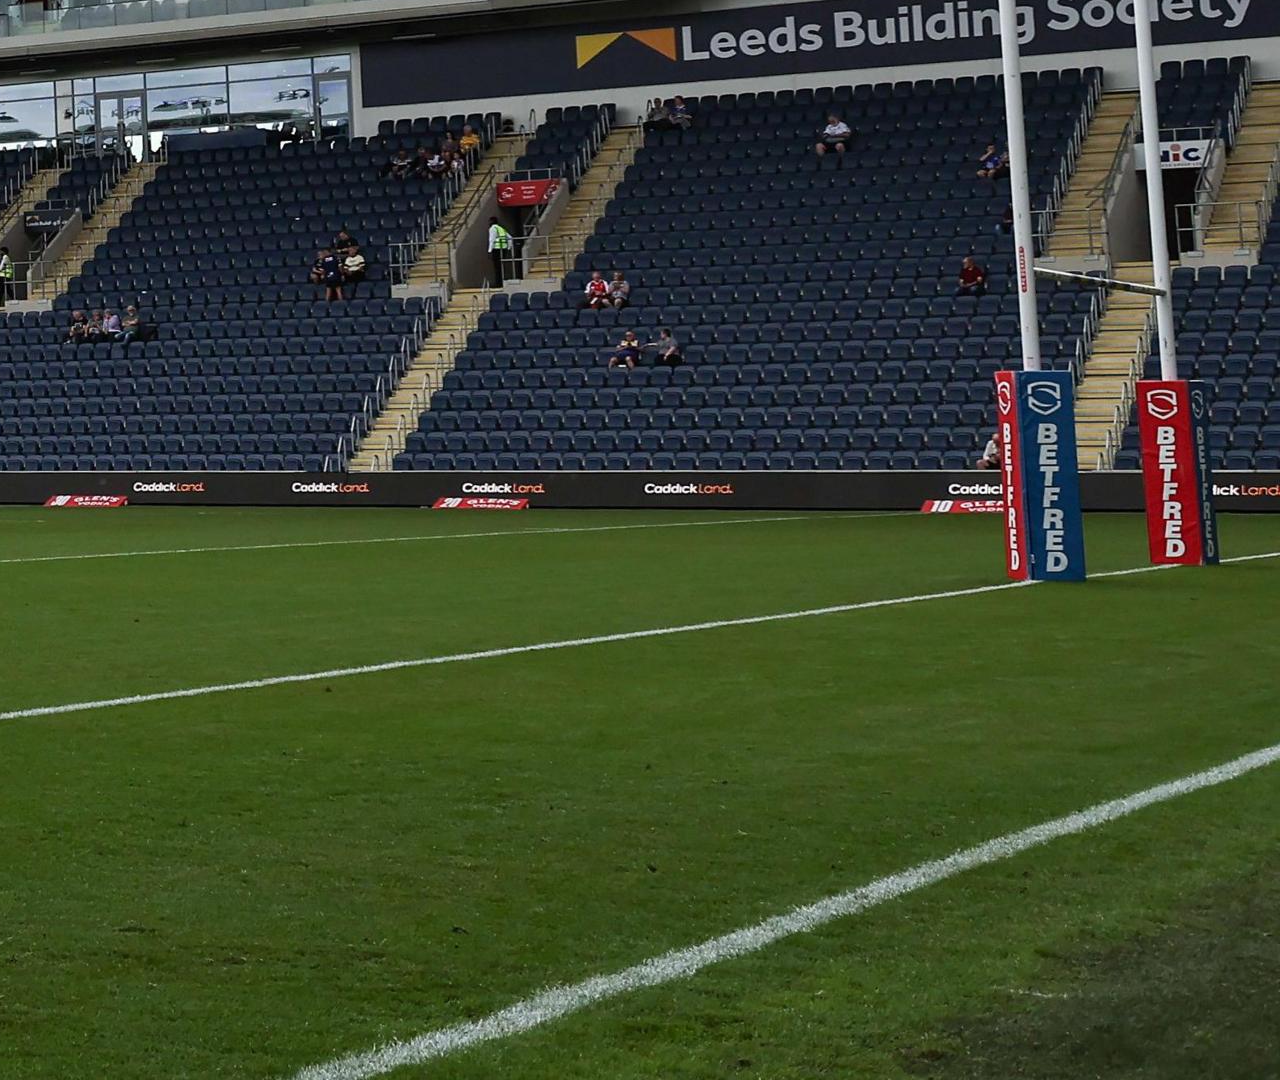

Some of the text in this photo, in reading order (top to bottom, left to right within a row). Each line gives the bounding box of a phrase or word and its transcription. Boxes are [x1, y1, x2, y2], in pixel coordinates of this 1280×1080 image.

[682, 15, 823, 61] Leeds
[835, 0, 1036, 49] Building
[440, 498, 462, 508] 20
[930, 501, 953, 512] 10
[1002, 422, 1020, 570] BETFRED
[1037, 423, 1069, 573] BETFRED
[1156, 426, 1186, 558] BETFRED
[1196, 426, 1214, 558] BETFRED
